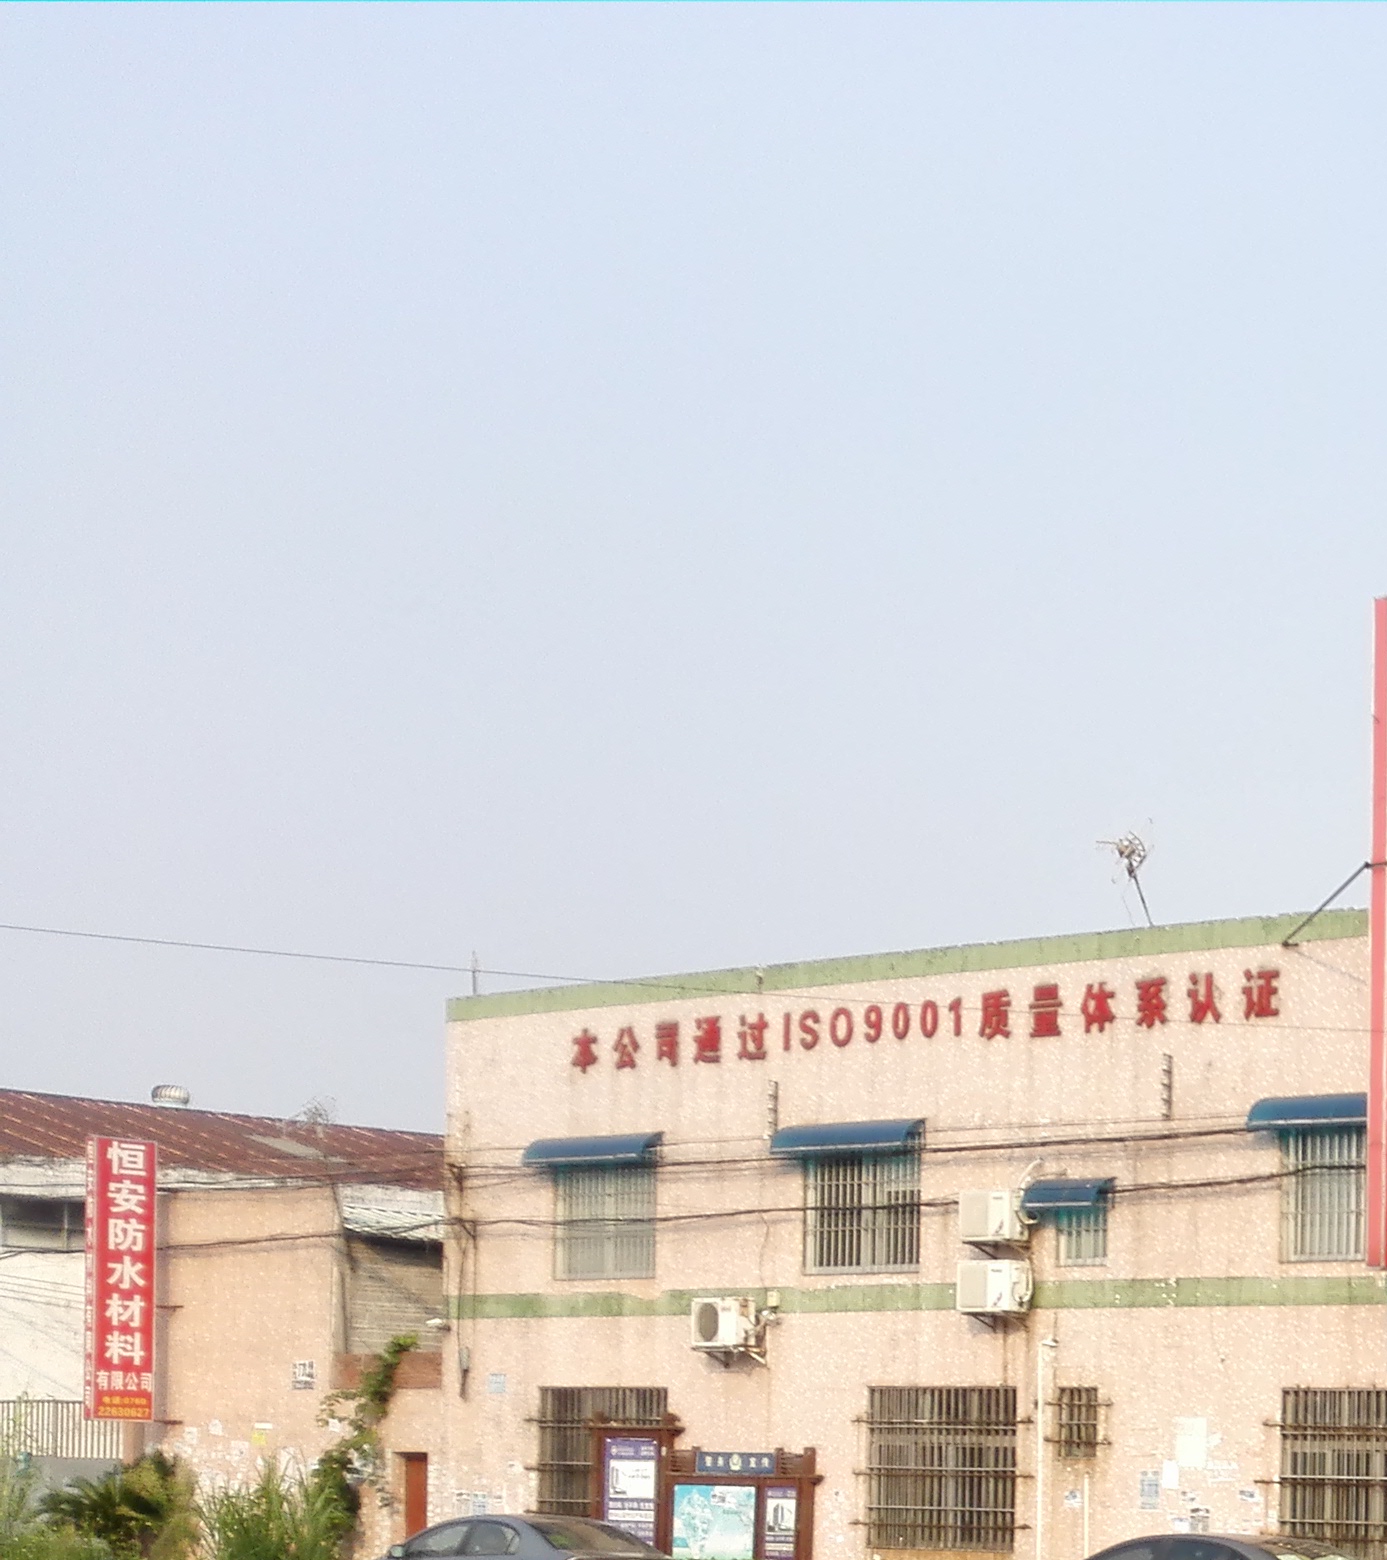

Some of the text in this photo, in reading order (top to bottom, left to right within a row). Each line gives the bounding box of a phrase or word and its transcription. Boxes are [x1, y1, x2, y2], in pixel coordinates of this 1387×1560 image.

[105, 1140, 148, 1367] 恒安防水材料
[96, 1369, 153, 1393] 有限公司
